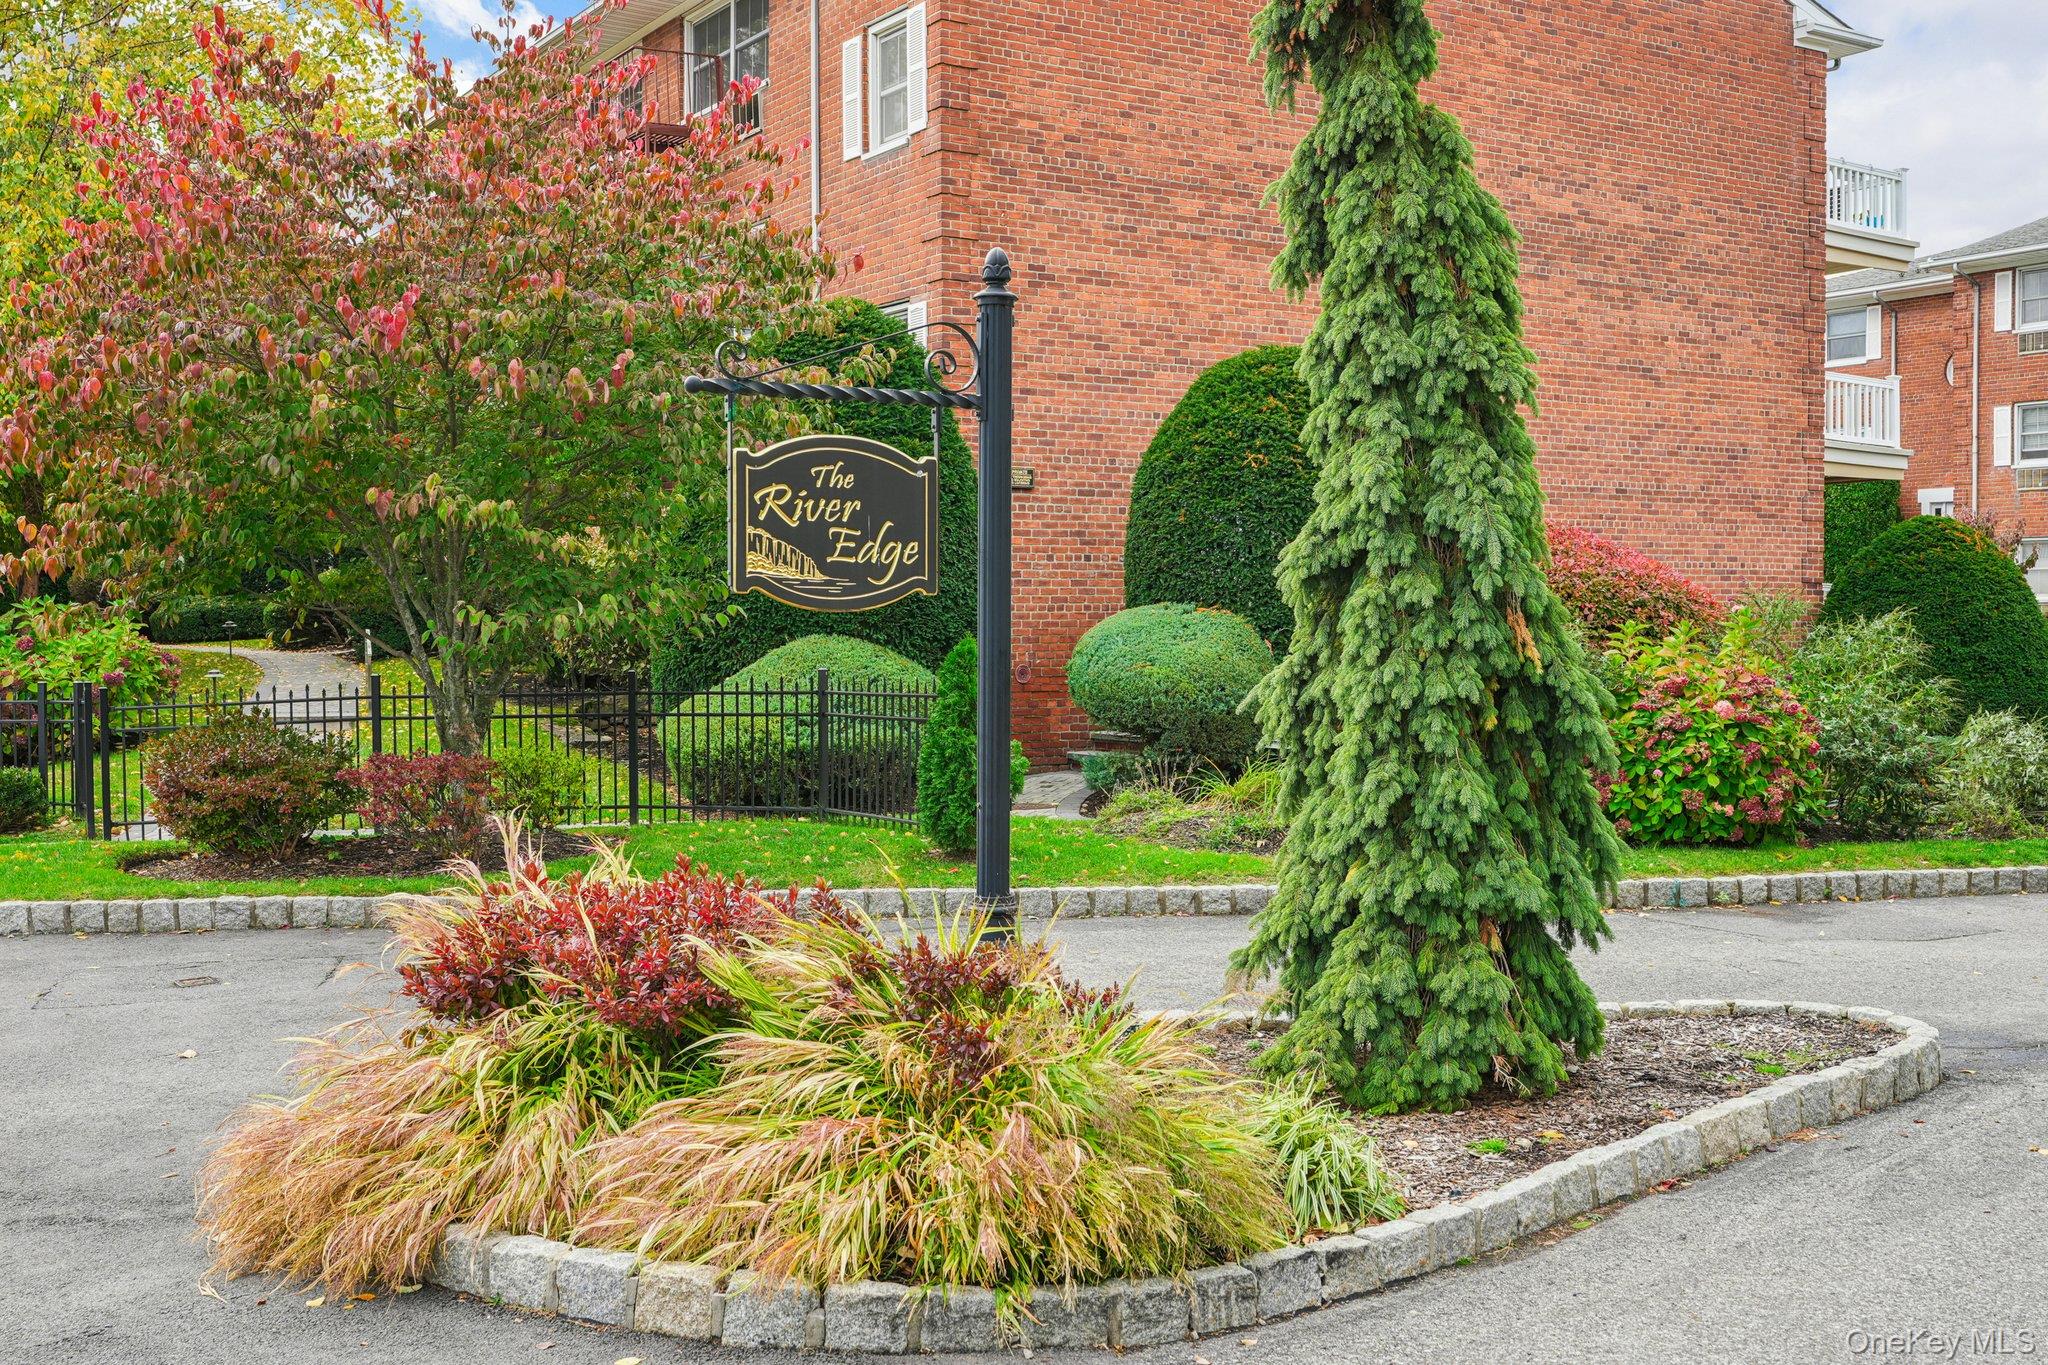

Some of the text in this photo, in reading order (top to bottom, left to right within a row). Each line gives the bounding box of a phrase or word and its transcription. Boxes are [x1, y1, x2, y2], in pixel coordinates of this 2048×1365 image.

[810, 460, 855, 489] The
[753, 482, 861, 527] River
[826, 520, 919, 585] Edge
